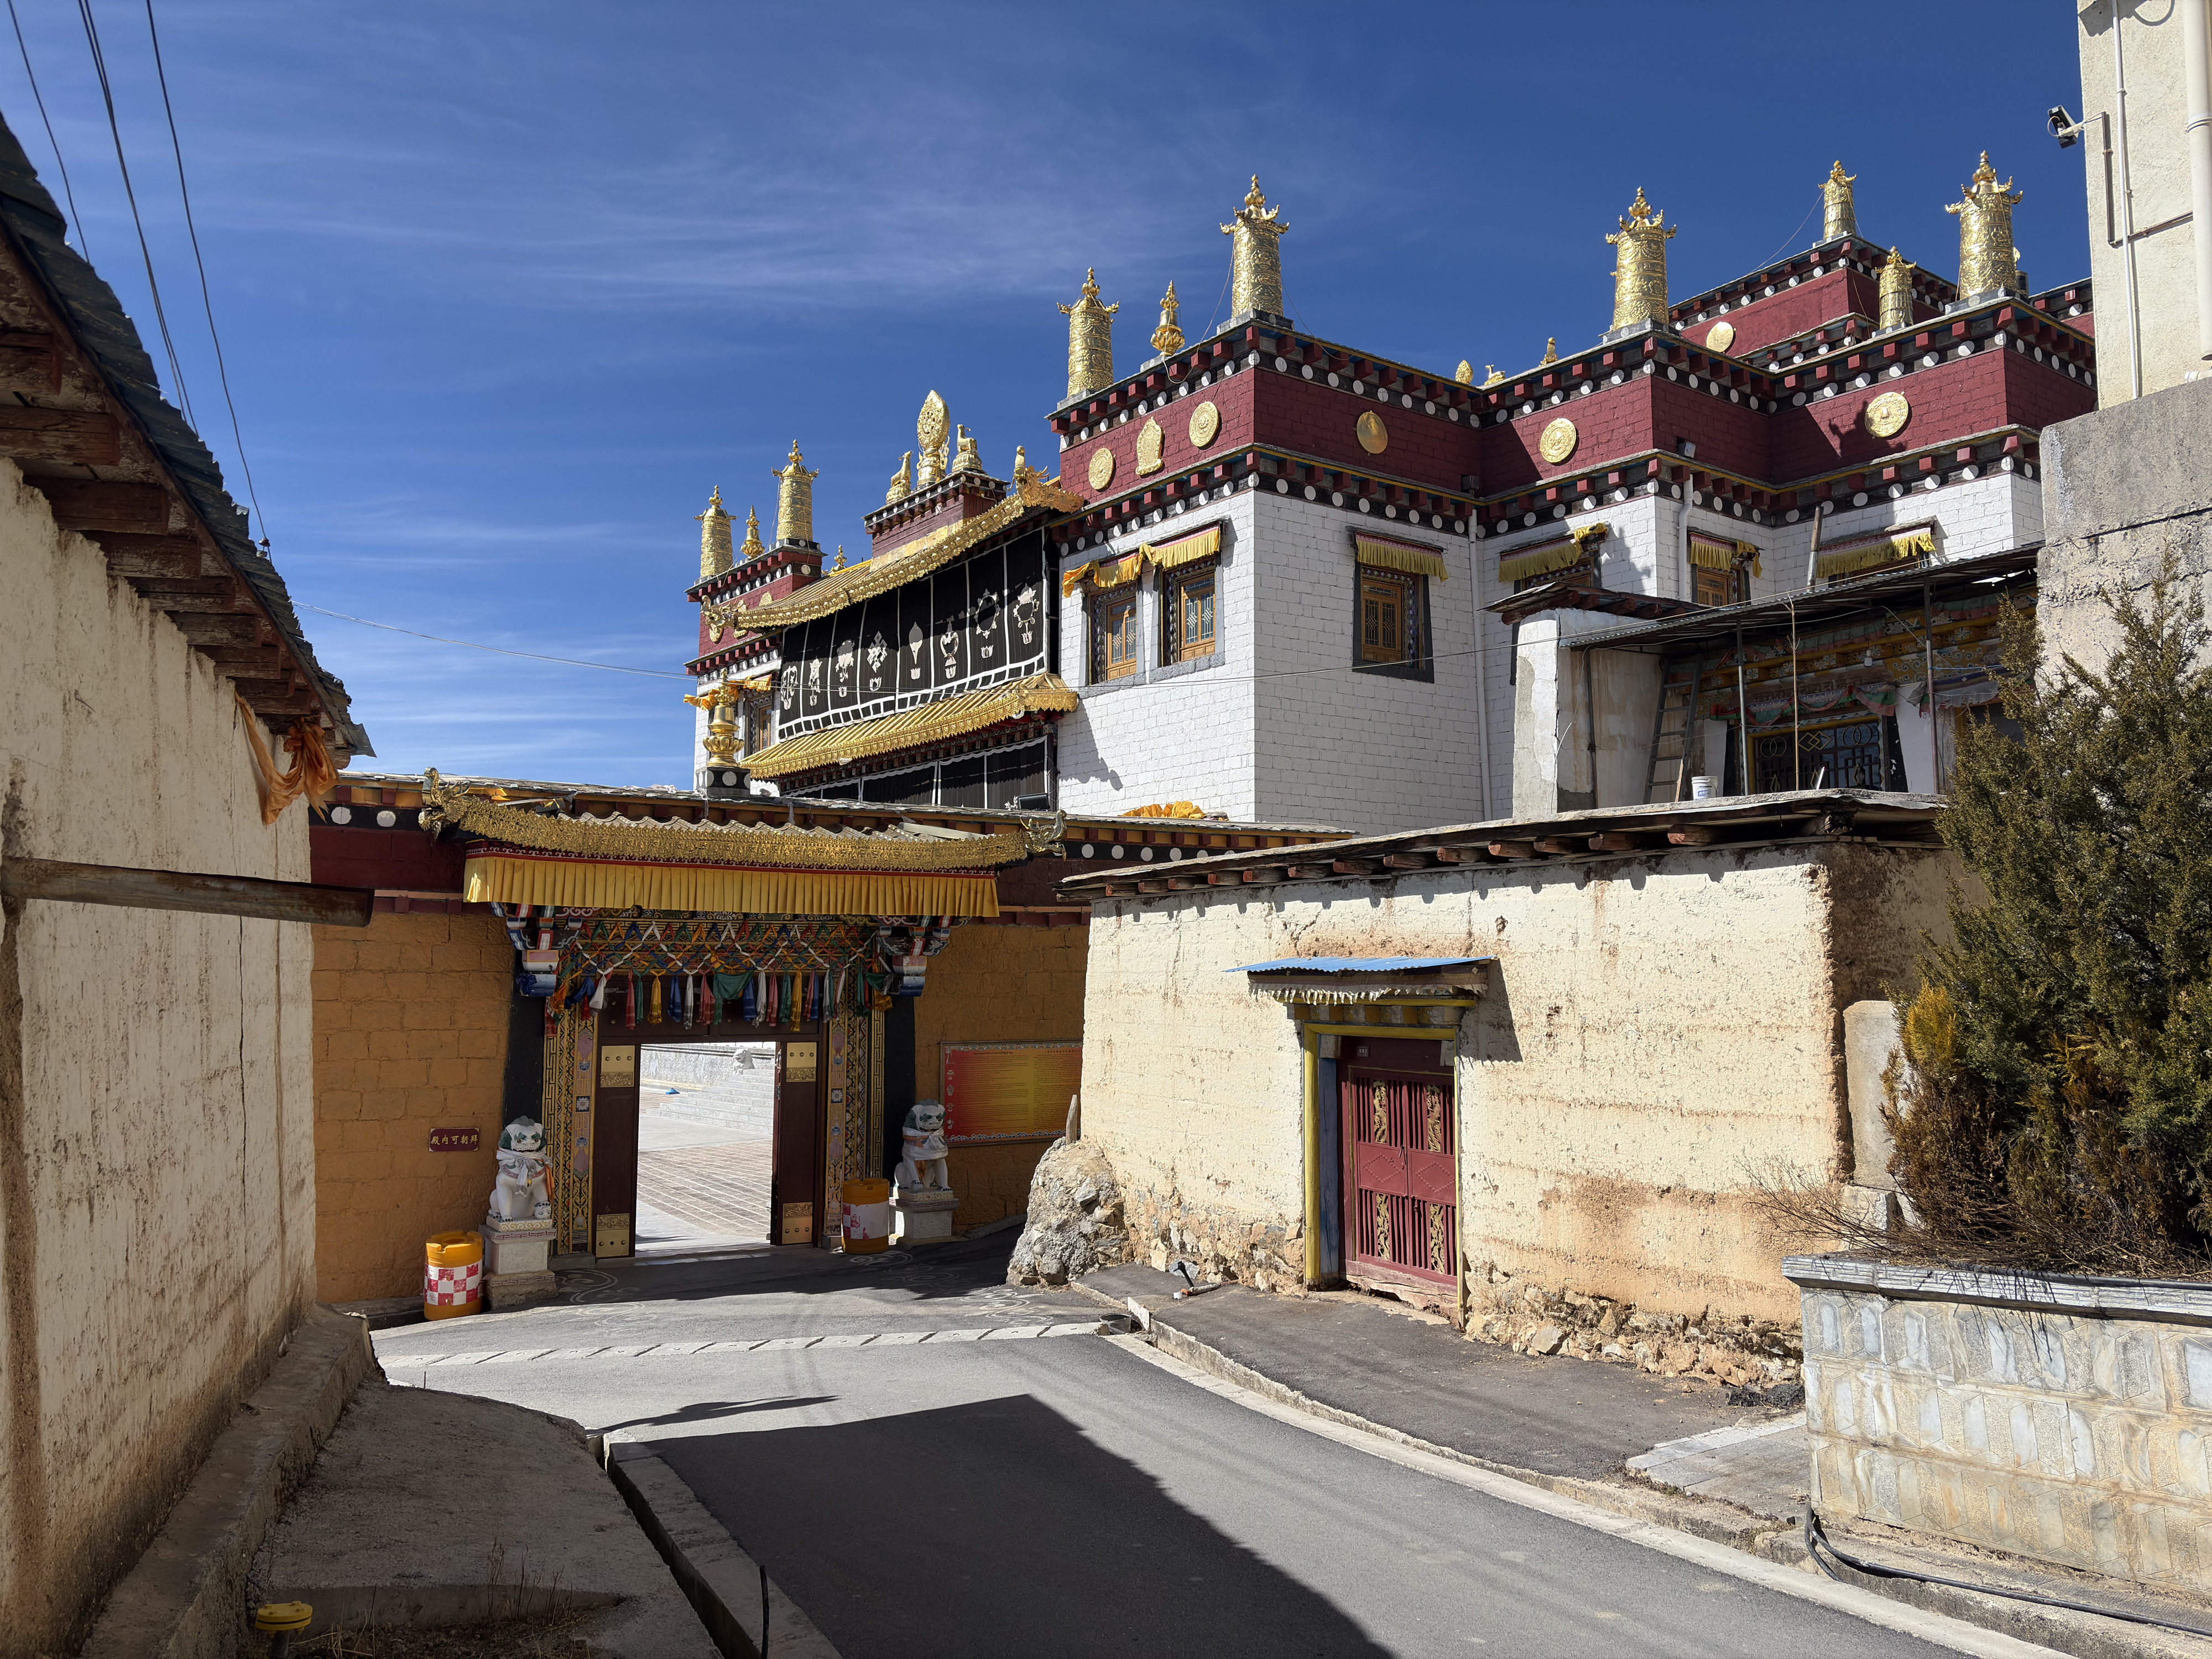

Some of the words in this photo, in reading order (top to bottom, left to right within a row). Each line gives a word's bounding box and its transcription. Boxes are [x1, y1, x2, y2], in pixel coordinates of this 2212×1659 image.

[430, 1134, 478, 1145] 殿内可朝拜
